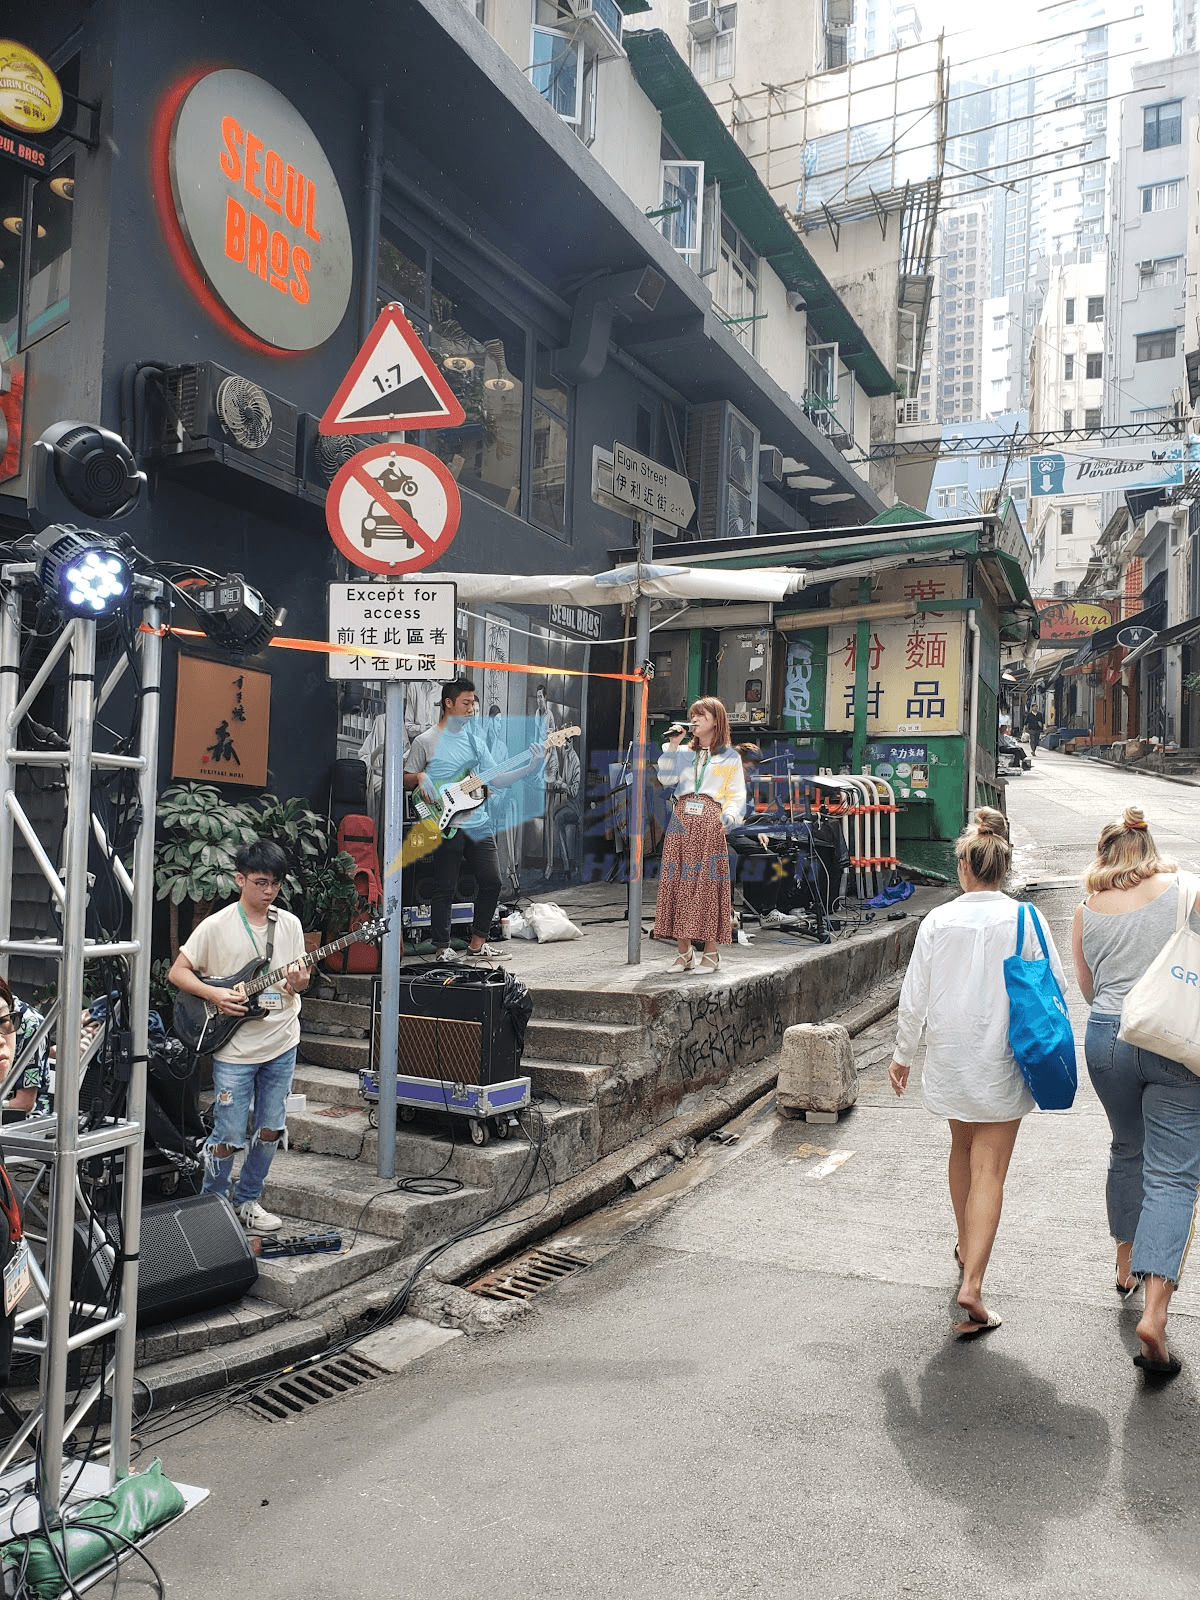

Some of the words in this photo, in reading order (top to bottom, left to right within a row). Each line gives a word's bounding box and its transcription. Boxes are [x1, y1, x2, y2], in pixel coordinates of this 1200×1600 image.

[18, 143, 46, 167] BROS
[219, 115, 321, 242] SEOUL
[225, 196, 312, 305] BROS
[371, 363, 403, 394] 1:7
[617, 450, 638, 472] Elgin
[640, 462, 668, 487] Street
[1076, 462, 1144, 480] Paradise
[616, 473, 667, 513] 伊利近街
[347, 588, 405, 603] Except
[414, 588, 438, 602] for
[364, 609, 421, 619] access
[551, 604, 576, 628] SEOUL
[577, 609, 600, 638] BROS
[337, 627, 448, 645] 前往此區者
[349, 653, 436, 671] 不在此限
[844, 630, 948, 672] 粉麵
[843, 681, 945, 719] 甜品
[890, 748, 925, 760] 全力支持
[200, 768, 227, 776] SUKIYAKI
[1170, 965, 1200, 989] GR
